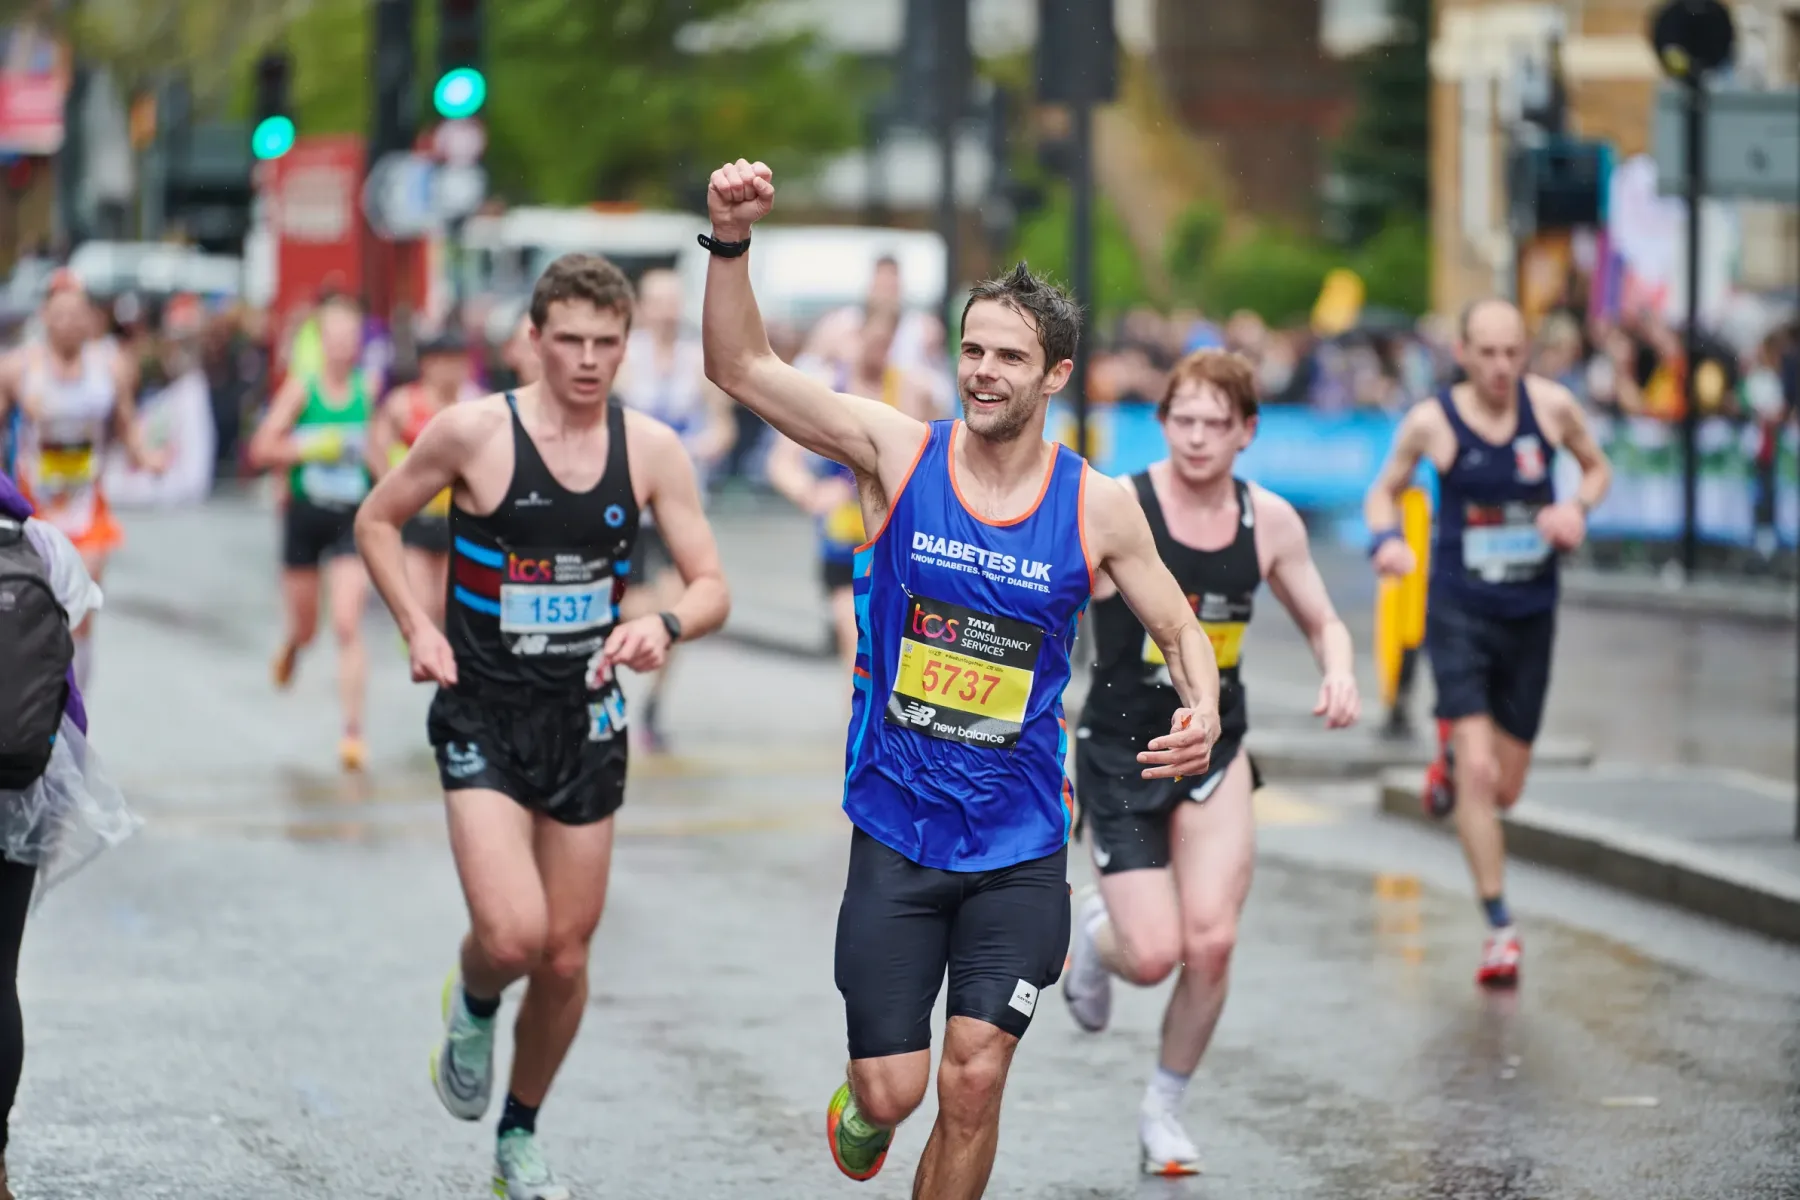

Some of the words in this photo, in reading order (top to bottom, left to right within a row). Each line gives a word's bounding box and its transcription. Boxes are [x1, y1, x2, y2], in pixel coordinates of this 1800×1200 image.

[508, 552, 552, 582] tcs
[911, 552, 935, 565] KNOW
[936, 559, 980, 575] DIABETES.
[981, 570, 1006, 583] FIGHT
[1007, 577, 1051, 593] DIABETES.
[1021, 559, 1053, 582] UK
[530, 594, 592, 623] 1537
[912, 603, 959, 643] tcs
[967, 616, 995, 632] TATA
[960, 638, 1005, 657] SERVICES
[963, 628, 1032, 651] CONSULTANCY
[922, 660, 1001, 705] 5737
[933, 721, 957, 734] new
[957, 726, 1005, 744] balance
